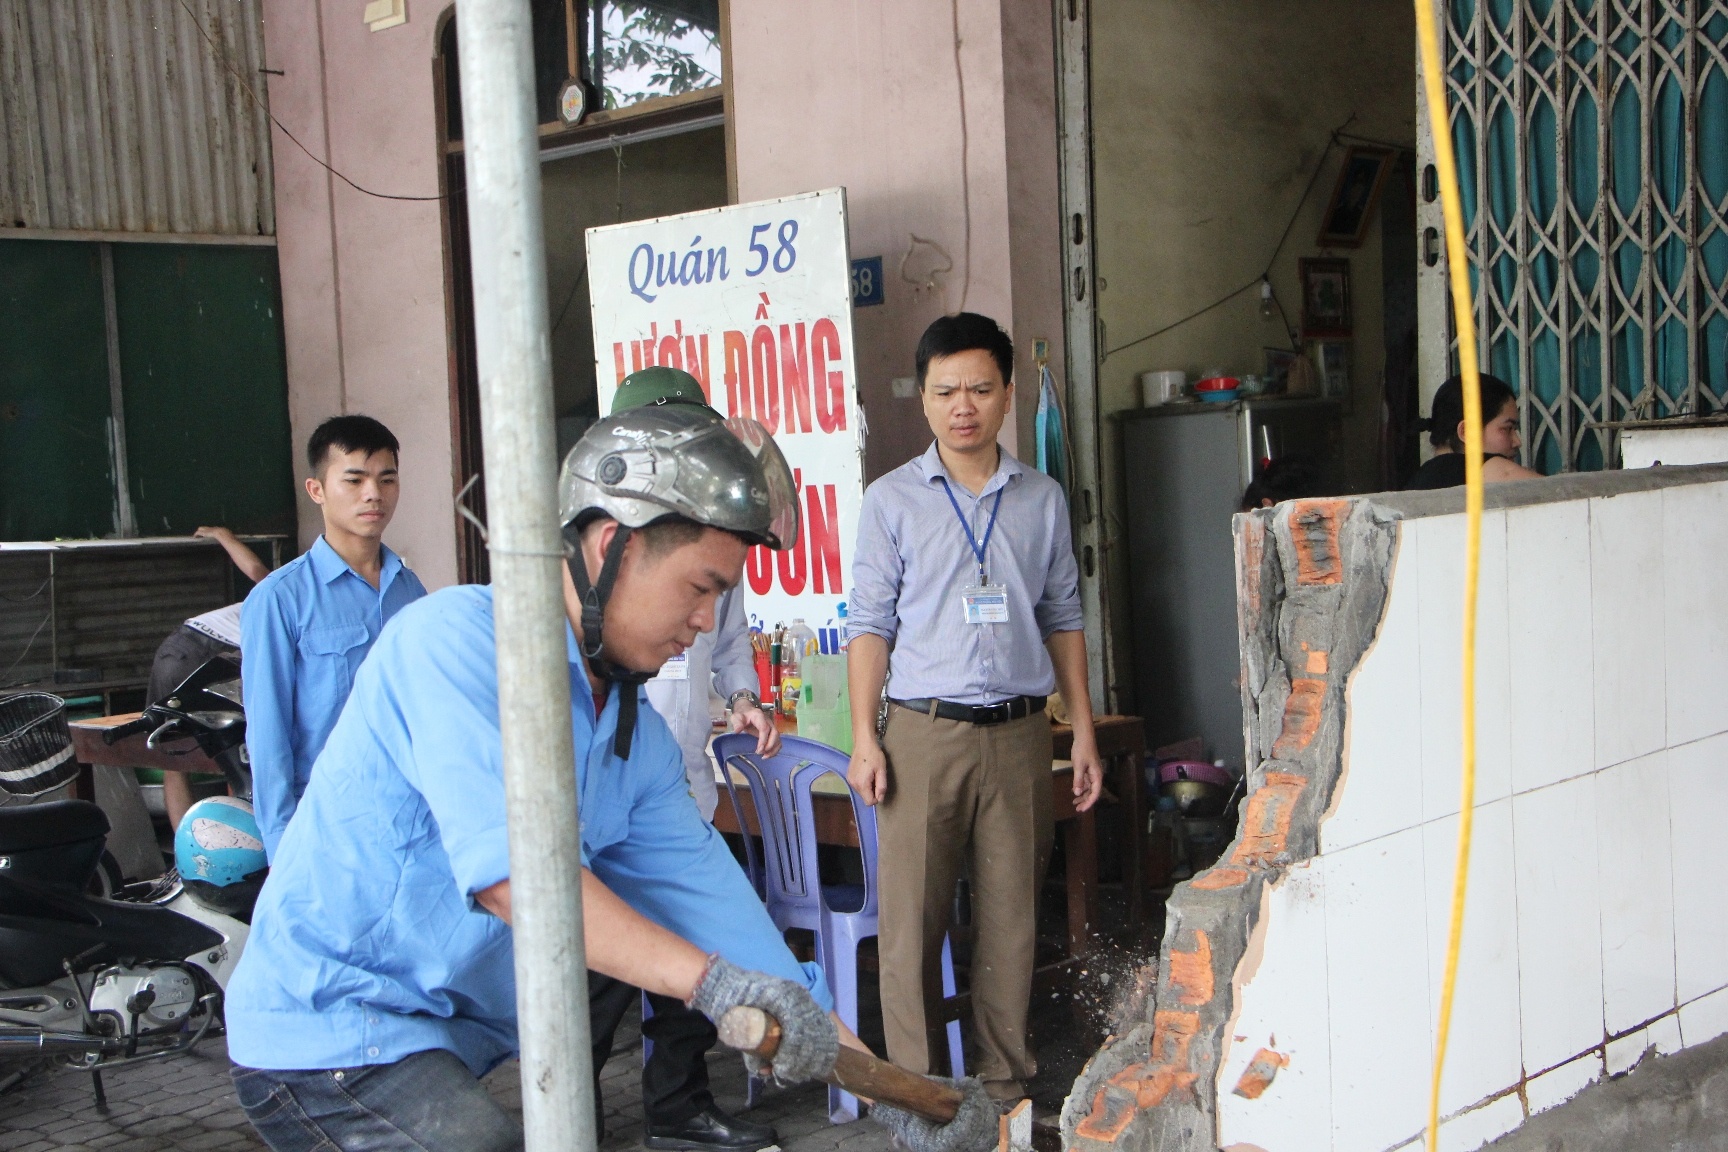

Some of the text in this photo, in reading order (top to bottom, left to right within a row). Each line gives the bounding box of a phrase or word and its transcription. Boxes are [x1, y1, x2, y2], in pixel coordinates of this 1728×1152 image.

[628, 219, 798, 303] Quán 58
[723, 292, 847, 438] ĐỒNG
